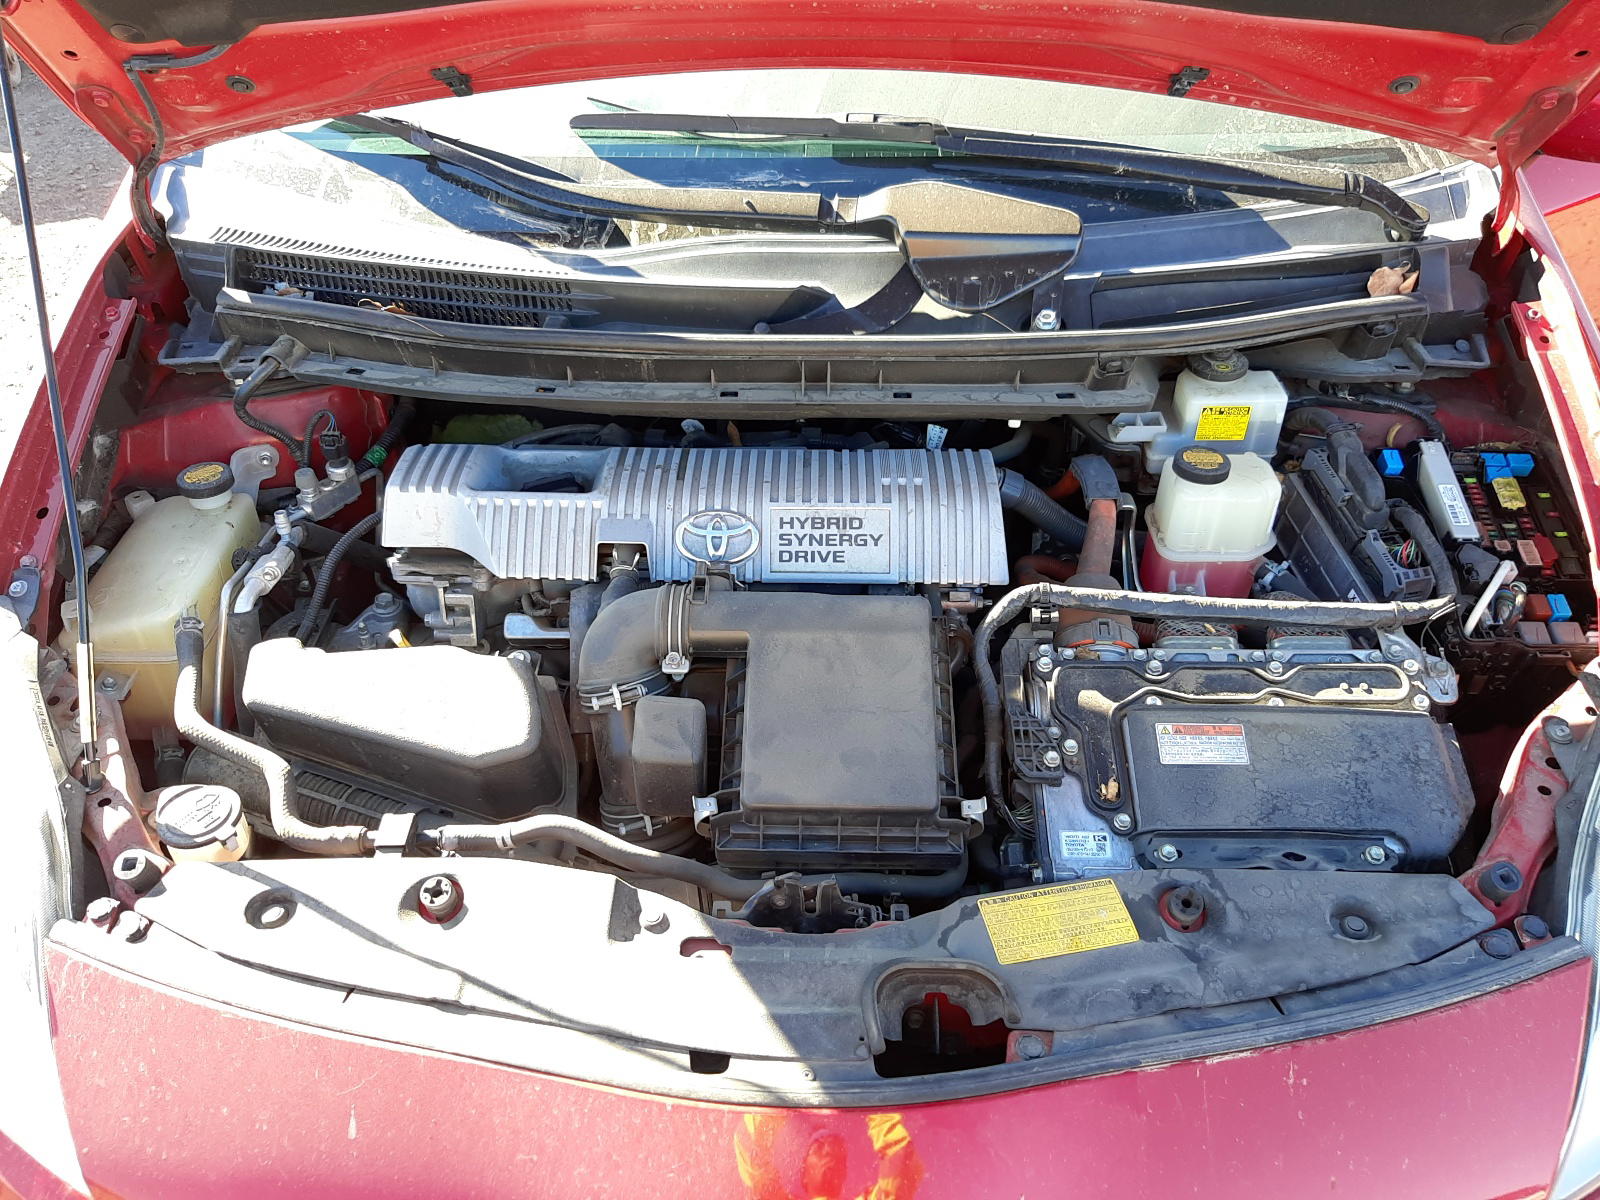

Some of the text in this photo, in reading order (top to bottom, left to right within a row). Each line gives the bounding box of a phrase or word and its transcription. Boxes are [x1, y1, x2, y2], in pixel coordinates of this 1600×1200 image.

[779, 517, 863, 530] HYBRID
[778, 533, 884, 547] SYNERGY
[778, 550, 846, 563] DRIVE
[1005, 892, 1032, 902] CAUTION
[1036, 885, 1074, 897] ATTENTION
